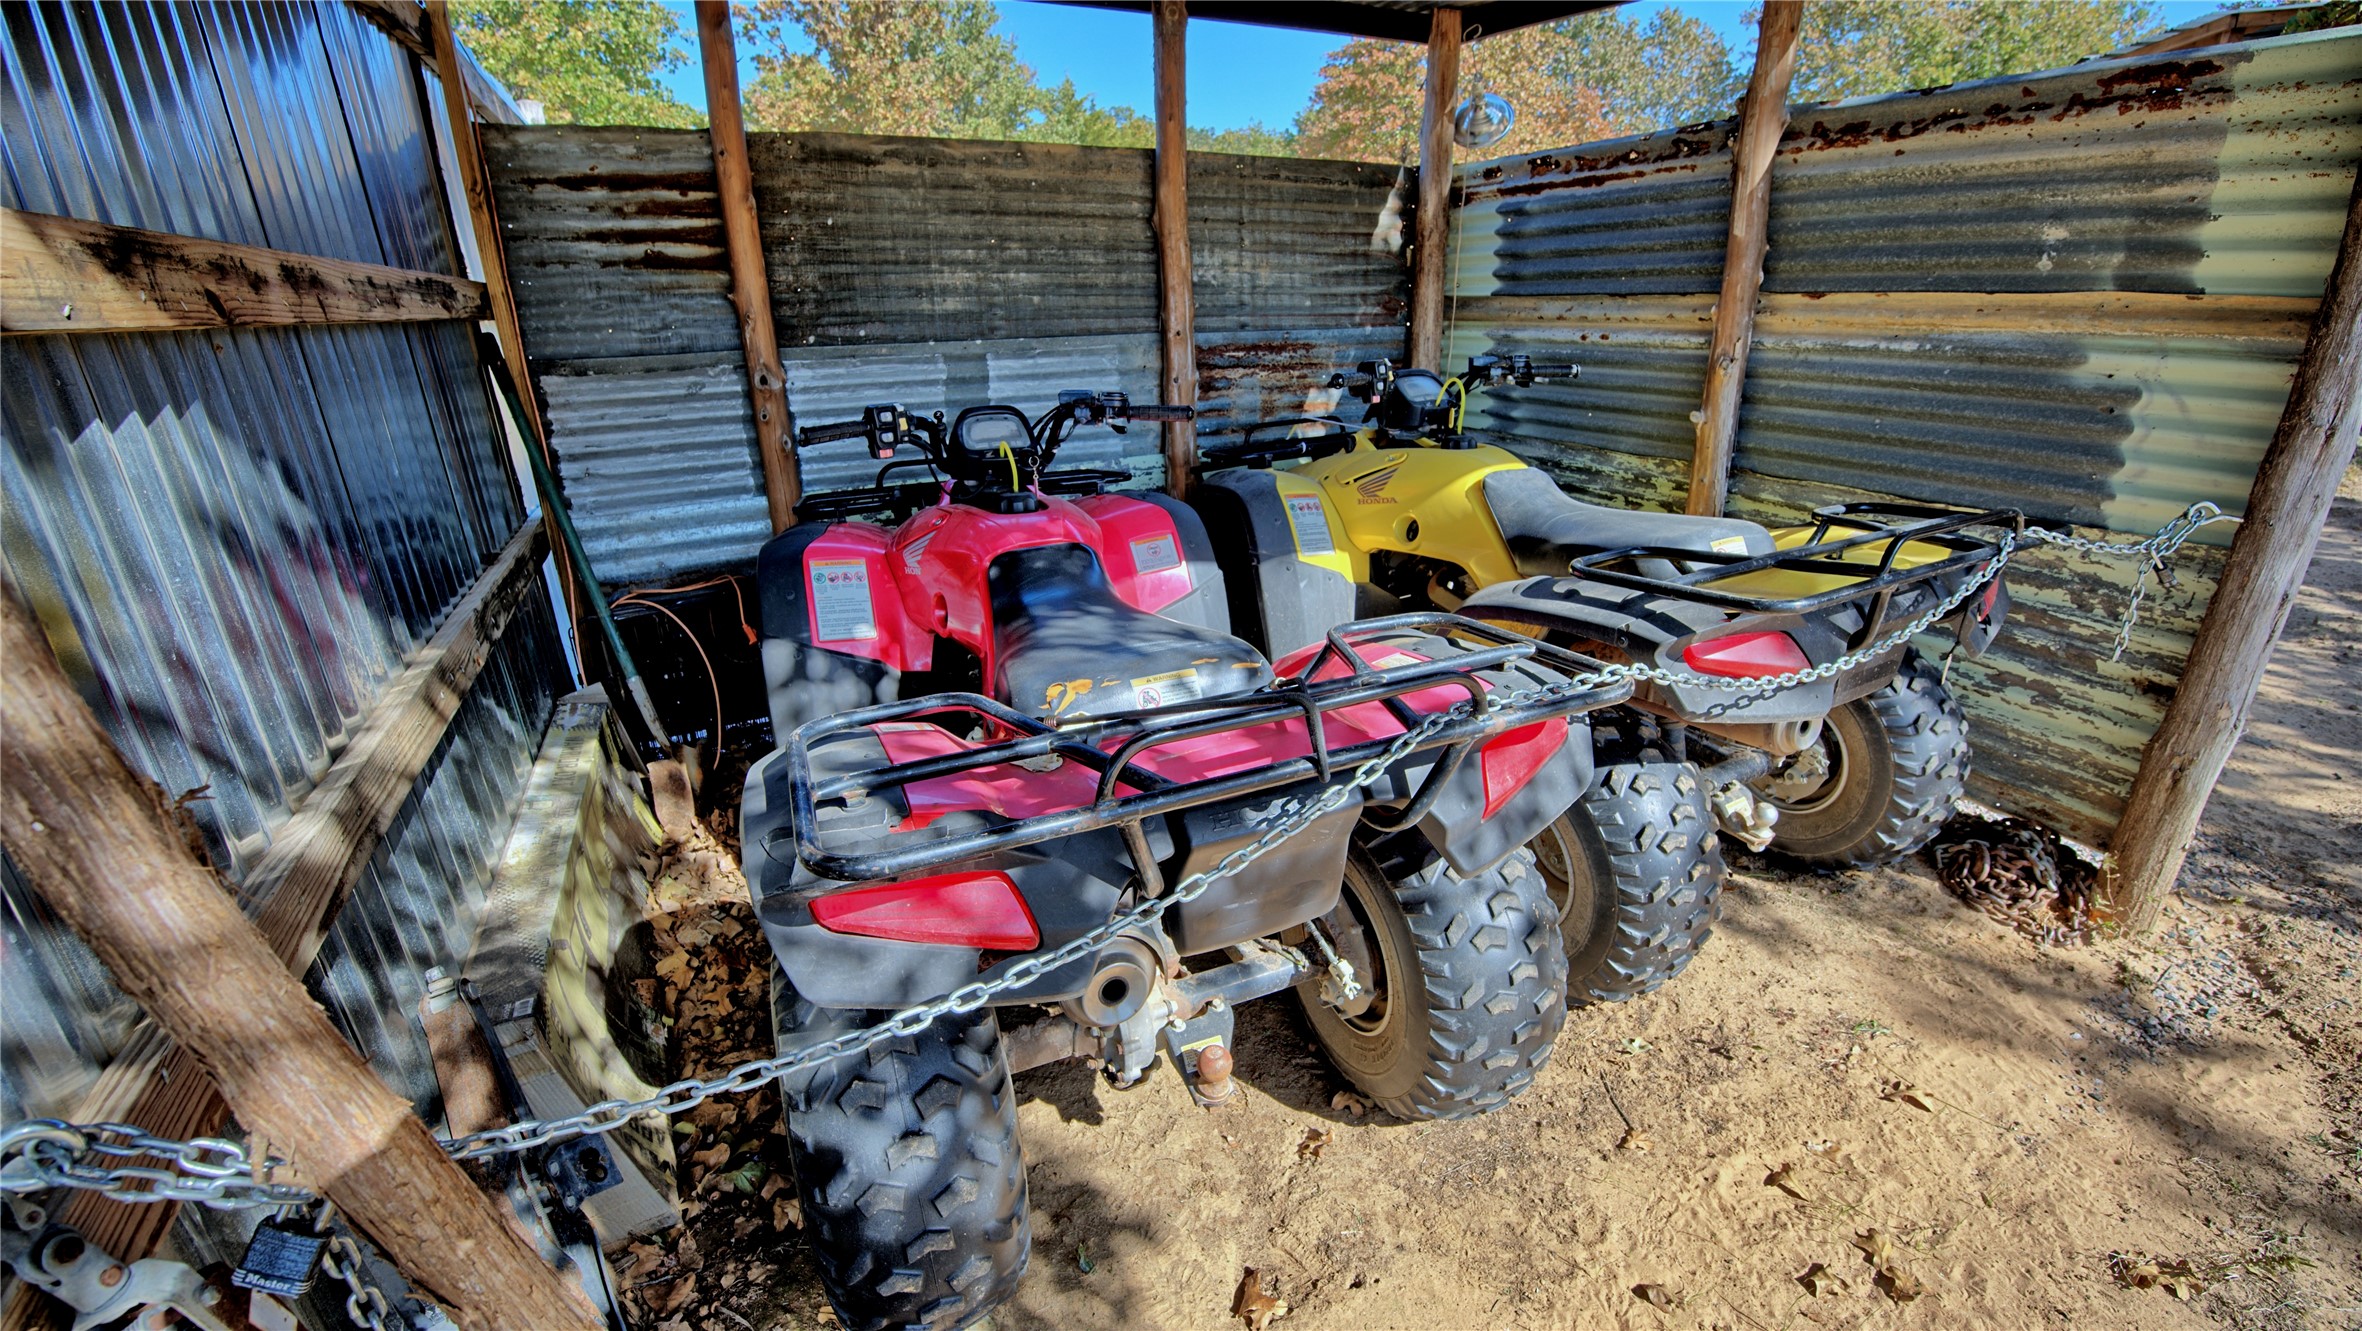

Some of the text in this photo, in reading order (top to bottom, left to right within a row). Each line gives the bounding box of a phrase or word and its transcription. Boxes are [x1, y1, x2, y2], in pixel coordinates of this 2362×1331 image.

[1358, 497, 1398, 505] HONDA
[1153, 672, 1181, 681] WARNING
[245, 1272, 291, 1290] Master
